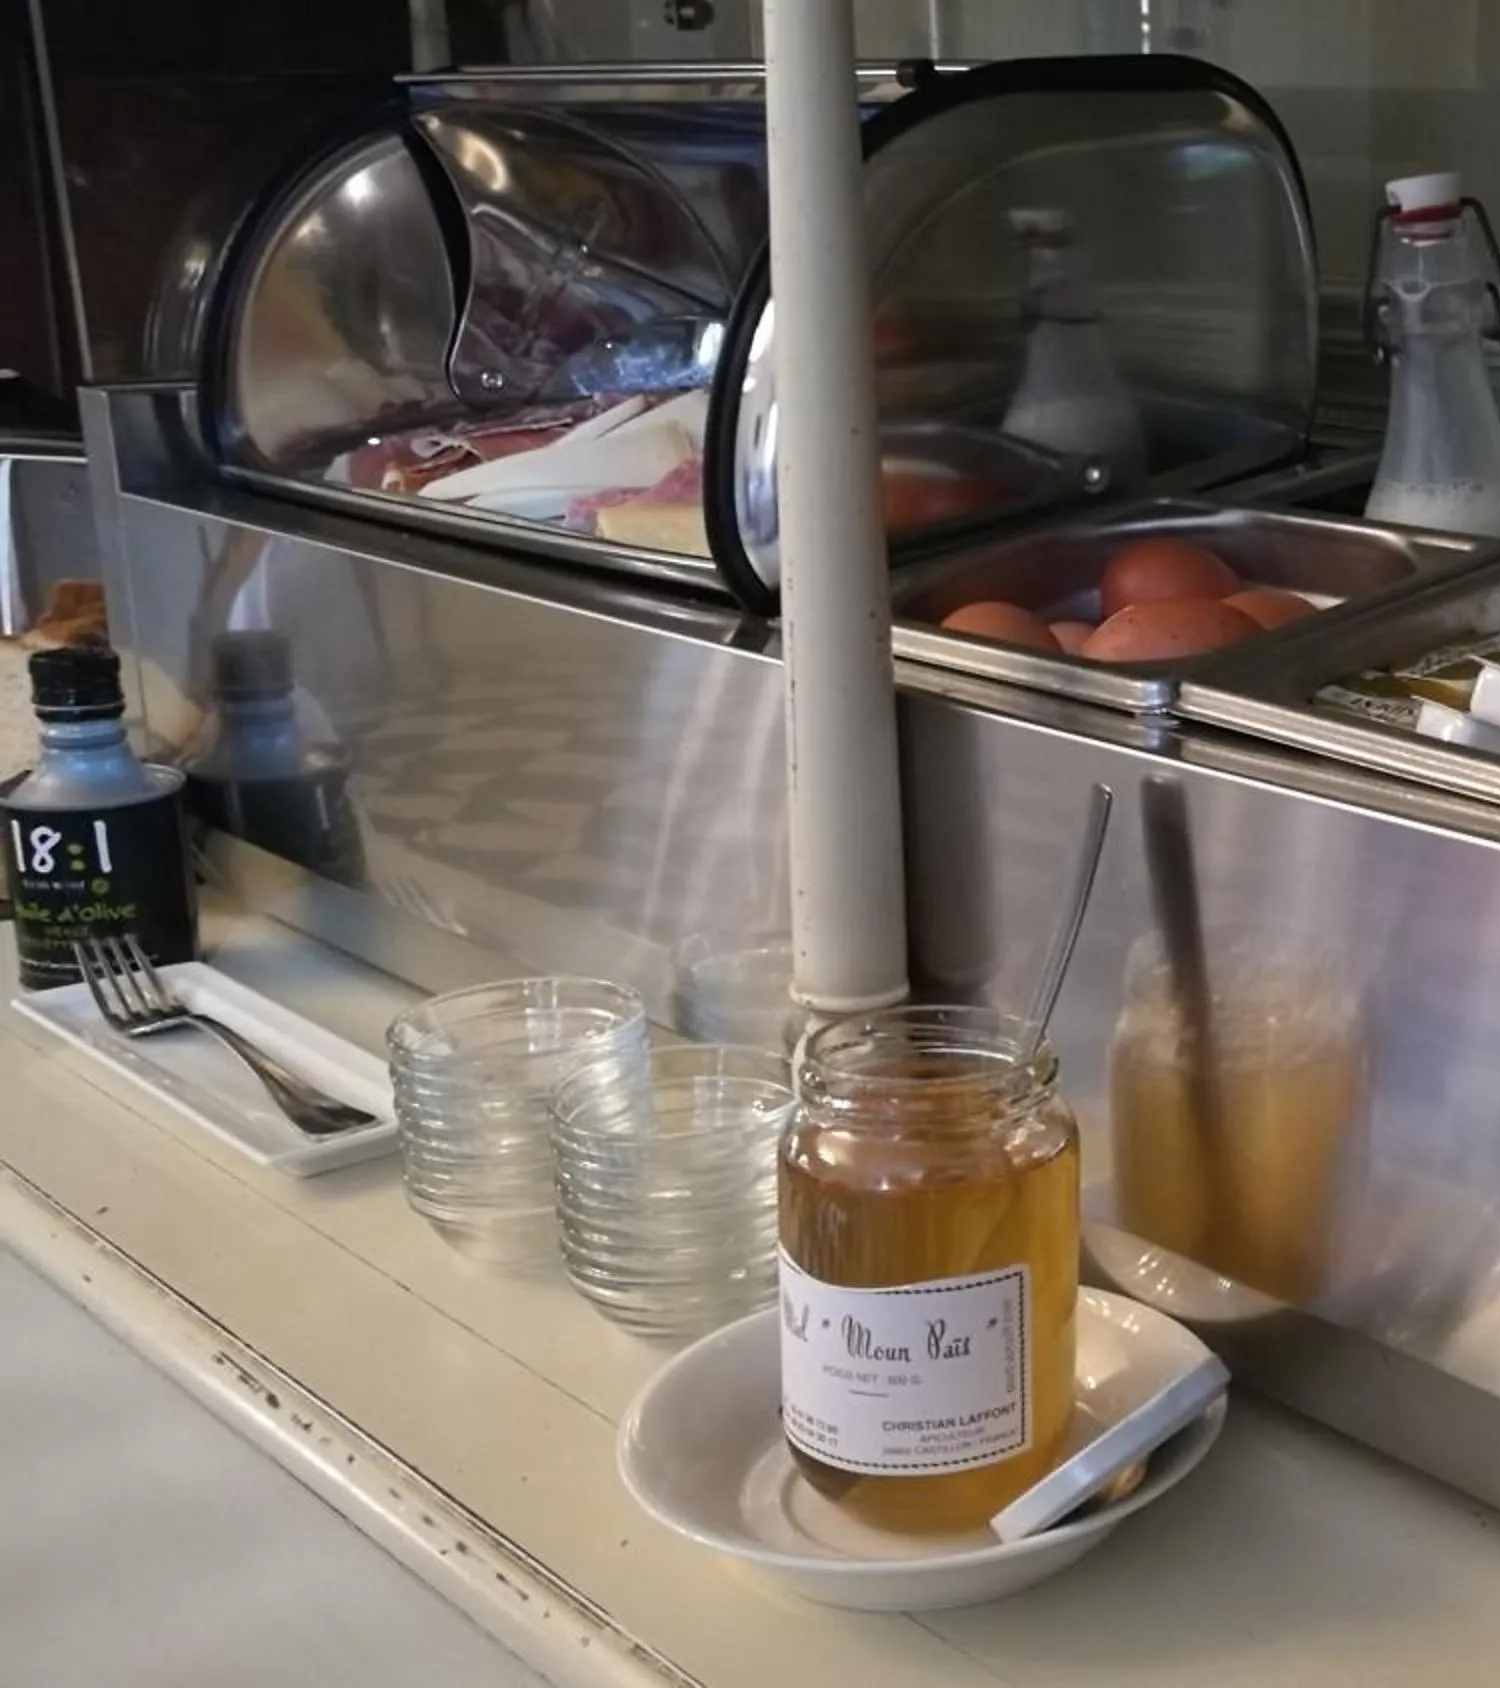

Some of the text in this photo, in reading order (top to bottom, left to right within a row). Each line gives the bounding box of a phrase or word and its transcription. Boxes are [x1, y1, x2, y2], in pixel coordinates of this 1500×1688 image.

[10, 818, 113, 874] 18:1
[840, 1313, 912, 1363] Moun
[881, 1401, 1017, 1433] CHRISTIAN LAFFONT
